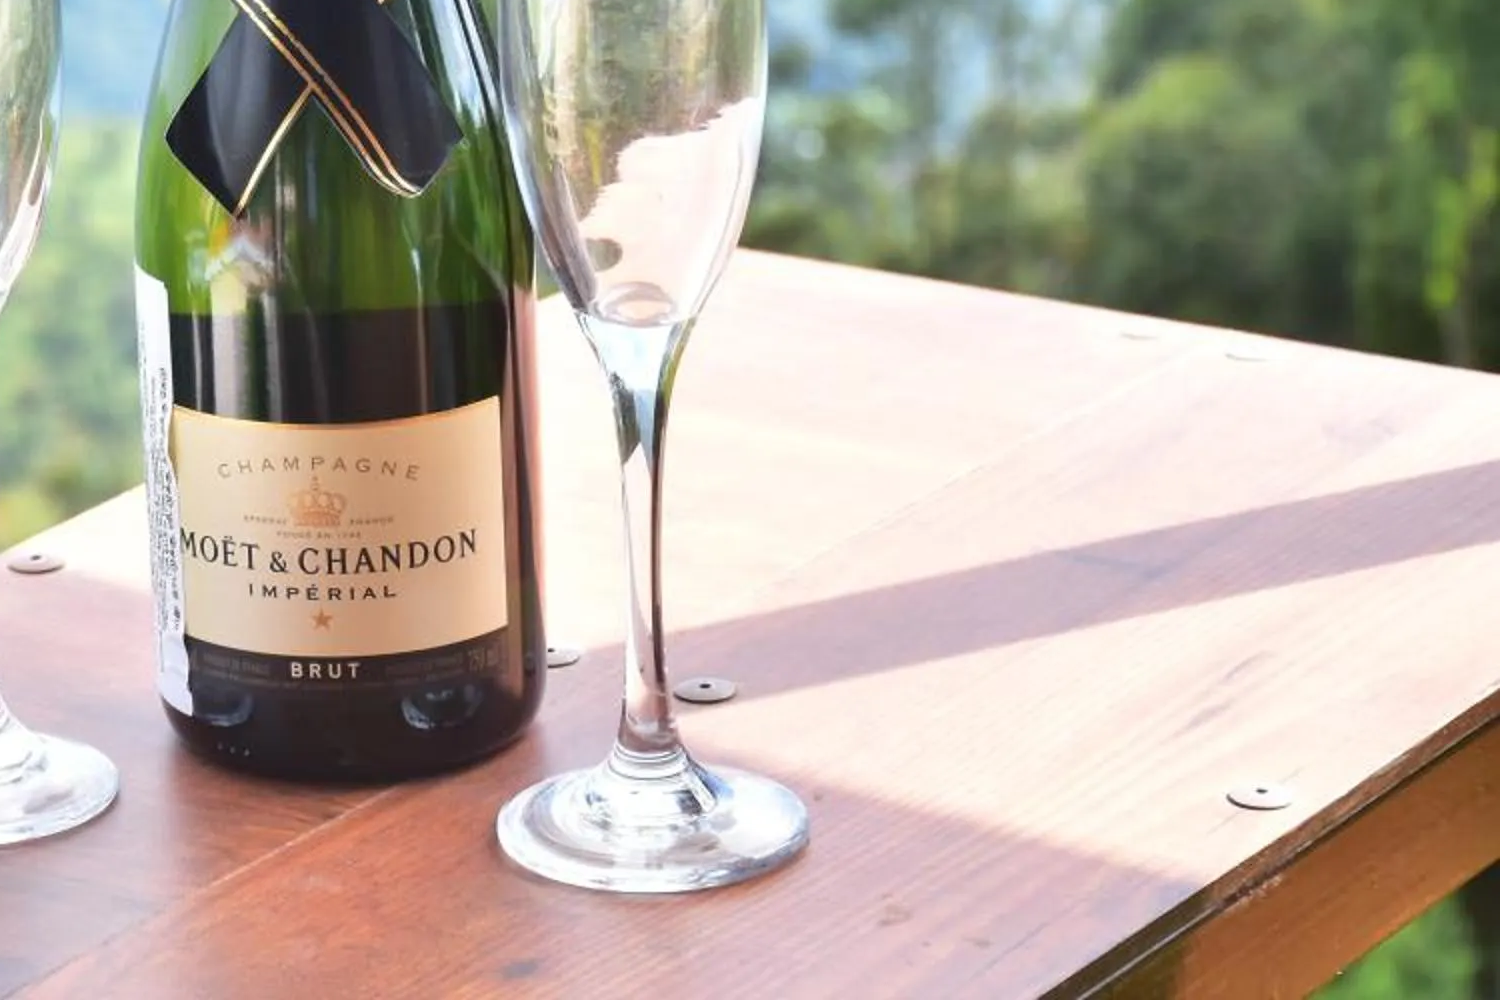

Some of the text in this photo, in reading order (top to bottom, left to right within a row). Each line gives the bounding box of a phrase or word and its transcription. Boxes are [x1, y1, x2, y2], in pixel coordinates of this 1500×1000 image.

[217, 456, 420, 481] CHAMPAGNE
[180, 527, 476, 575] MOËT & CHANDON
[249, 583, 396, 601] IMPÉRIAL
[290, 662, 361, 679] BRUT
